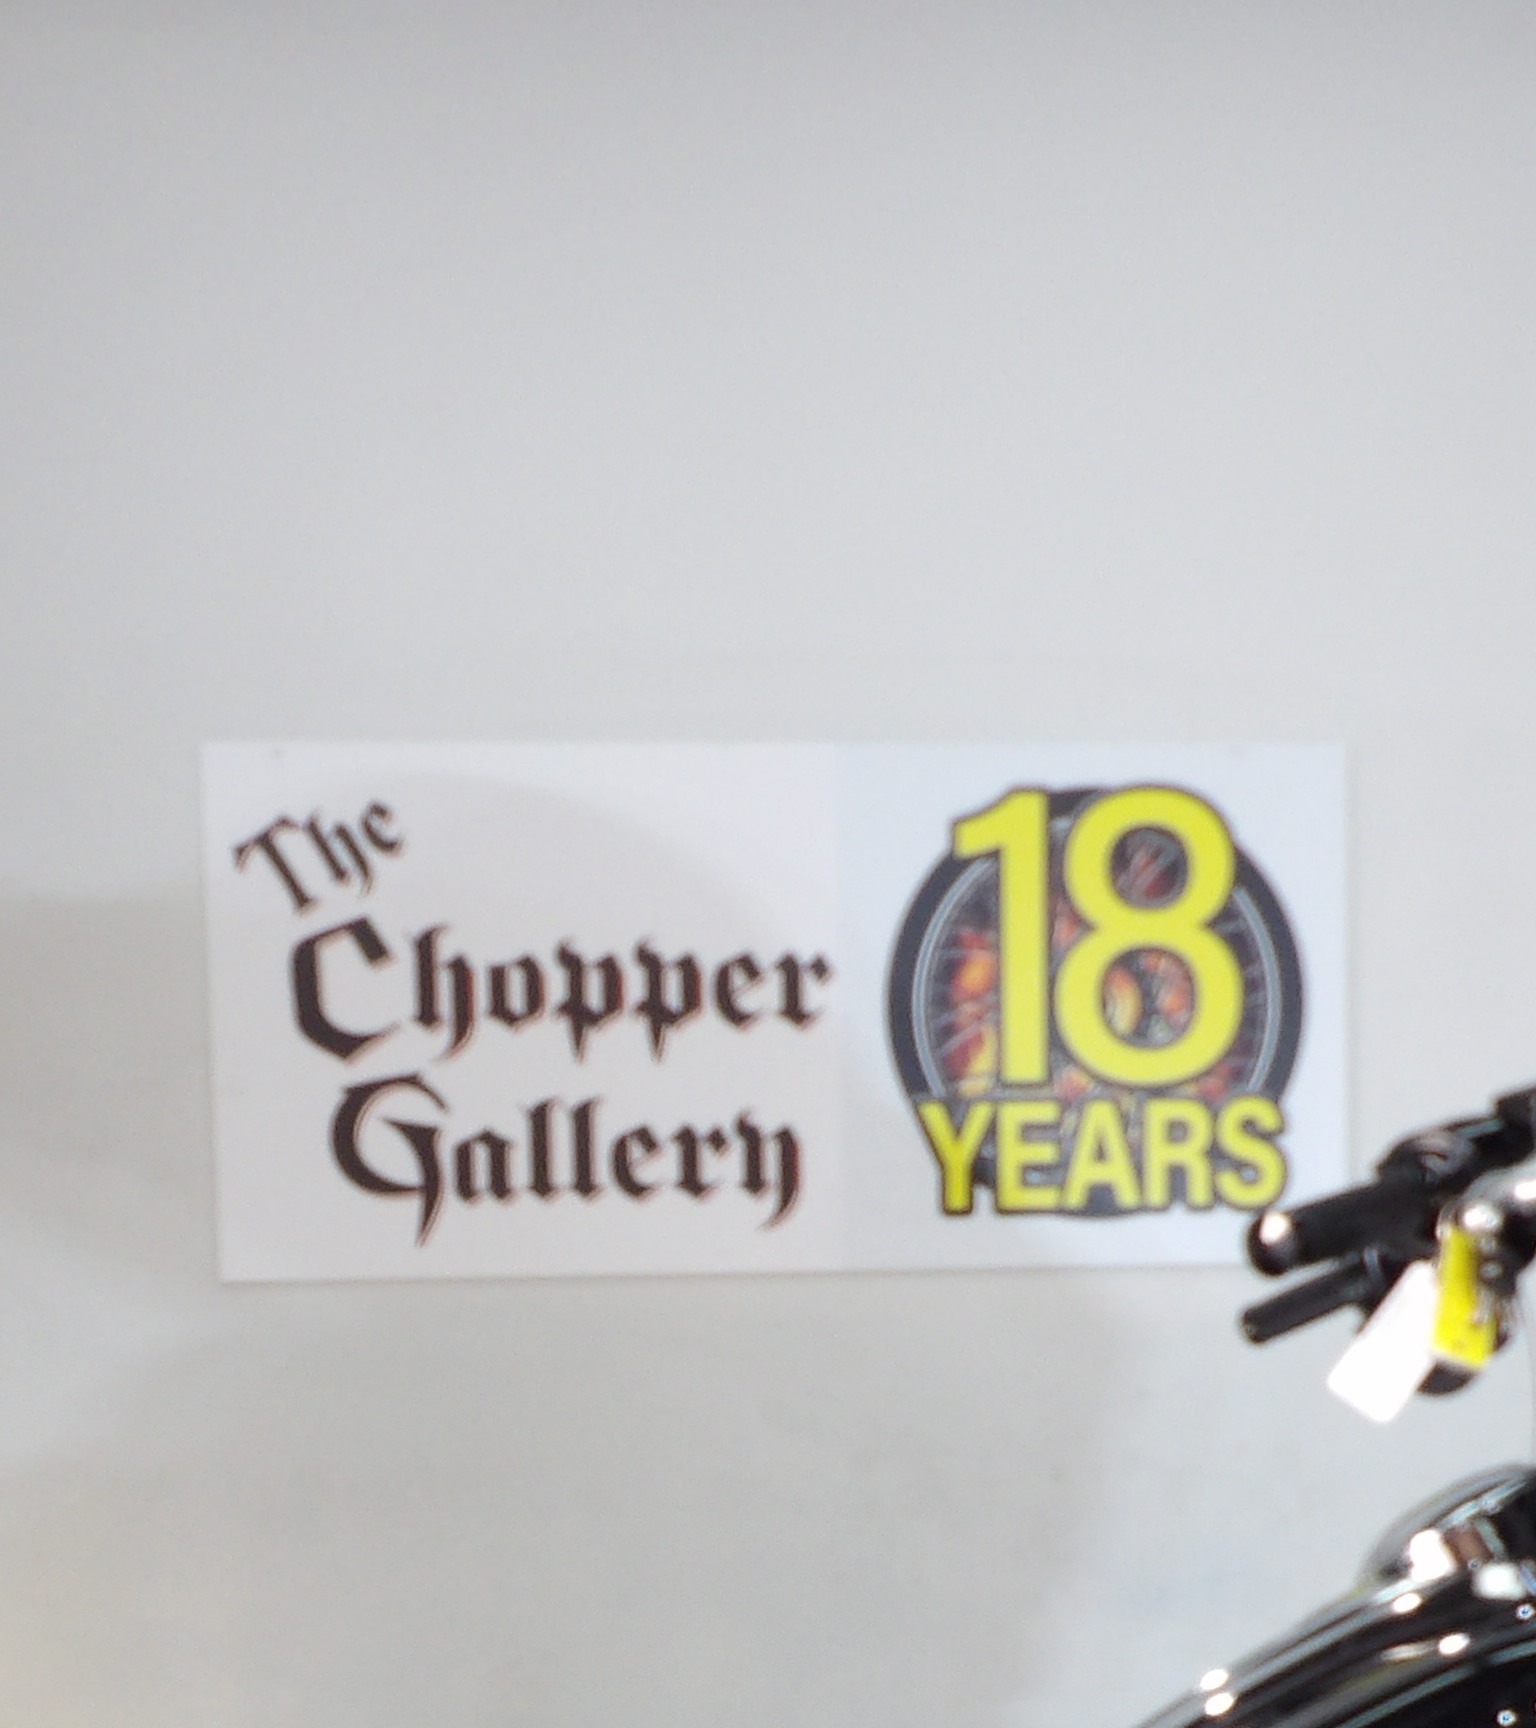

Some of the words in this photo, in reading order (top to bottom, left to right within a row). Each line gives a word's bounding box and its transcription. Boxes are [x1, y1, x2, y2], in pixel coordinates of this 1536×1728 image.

[231, 799, 403, 914] The
[287, 914, 833, 1064] Chopper
[950, 784, 1245, 1089] 18
[329, 1071, 802, 1248] Gallery
[917, 1094, 1290, 1216] YEARS
